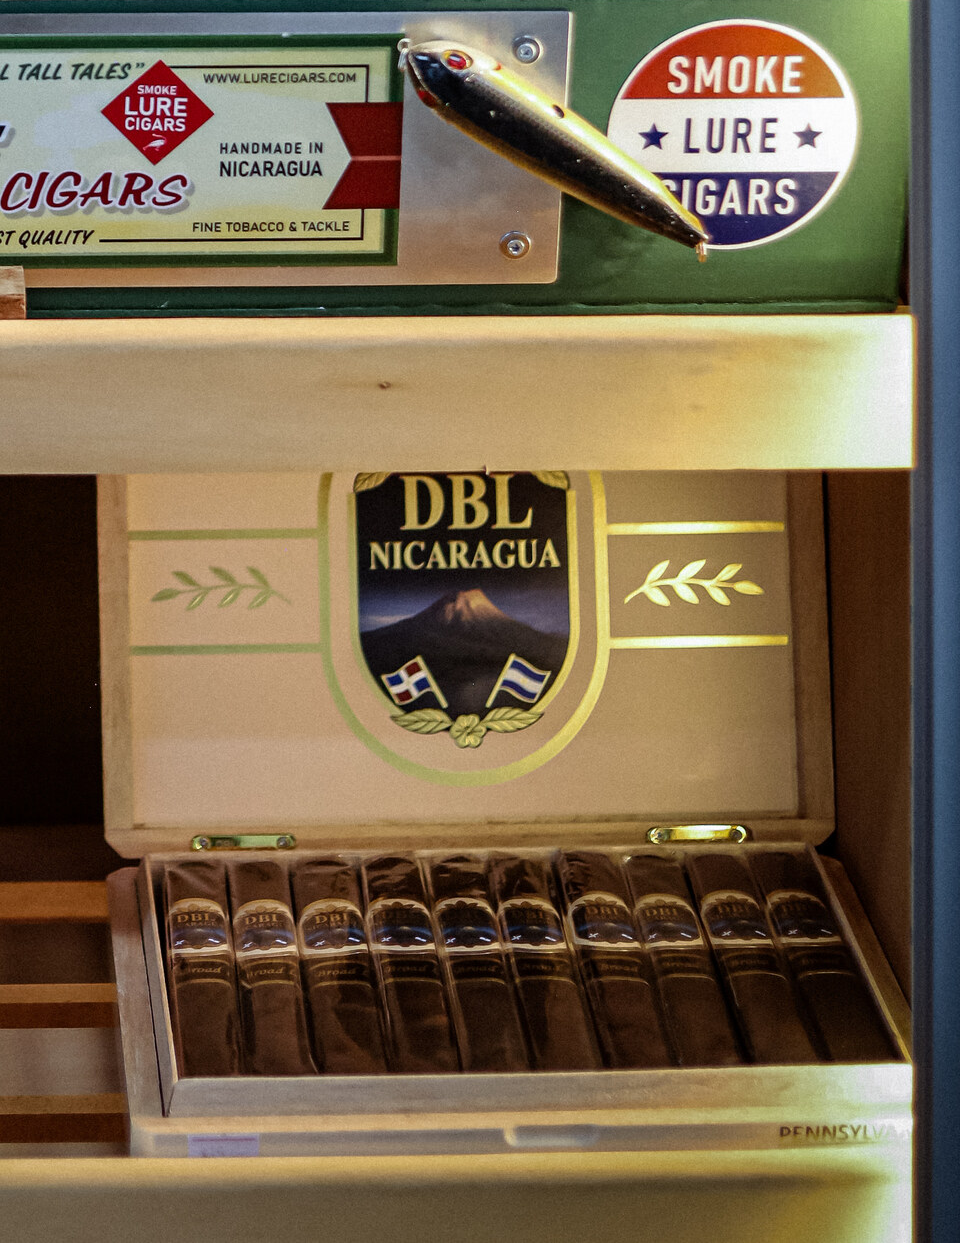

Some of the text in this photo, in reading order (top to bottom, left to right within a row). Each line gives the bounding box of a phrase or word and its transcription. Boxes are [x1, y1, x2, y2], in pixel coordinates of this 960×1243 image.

[17, 63, 67, 81] TALL
[70, 62, 146, 81] TALES"
[203, 72, 357, 84] WWW.LURECIGARS.COM
[667, 55, 804, 94] SMOKE
[137, 85, 177, 96] SMOKE
[124, 96, 188, 117] LURE
[124, 117, 187, 132] CIGARS
[683, 117, 779, 154] LURE
[219, 142, 324, 155] HANDMADE IN
[219, 160, 323, 178] NICARAGUA
[0, 171, 188, 212] CIGARS
[192, 220, 350, 233] FINE TOBACCO & TACKLE
[19, 229, 95, 247] QUALITY
[398, 473, 533, 531] DBL
[368, 538, 562, 570] NICARAGUA
